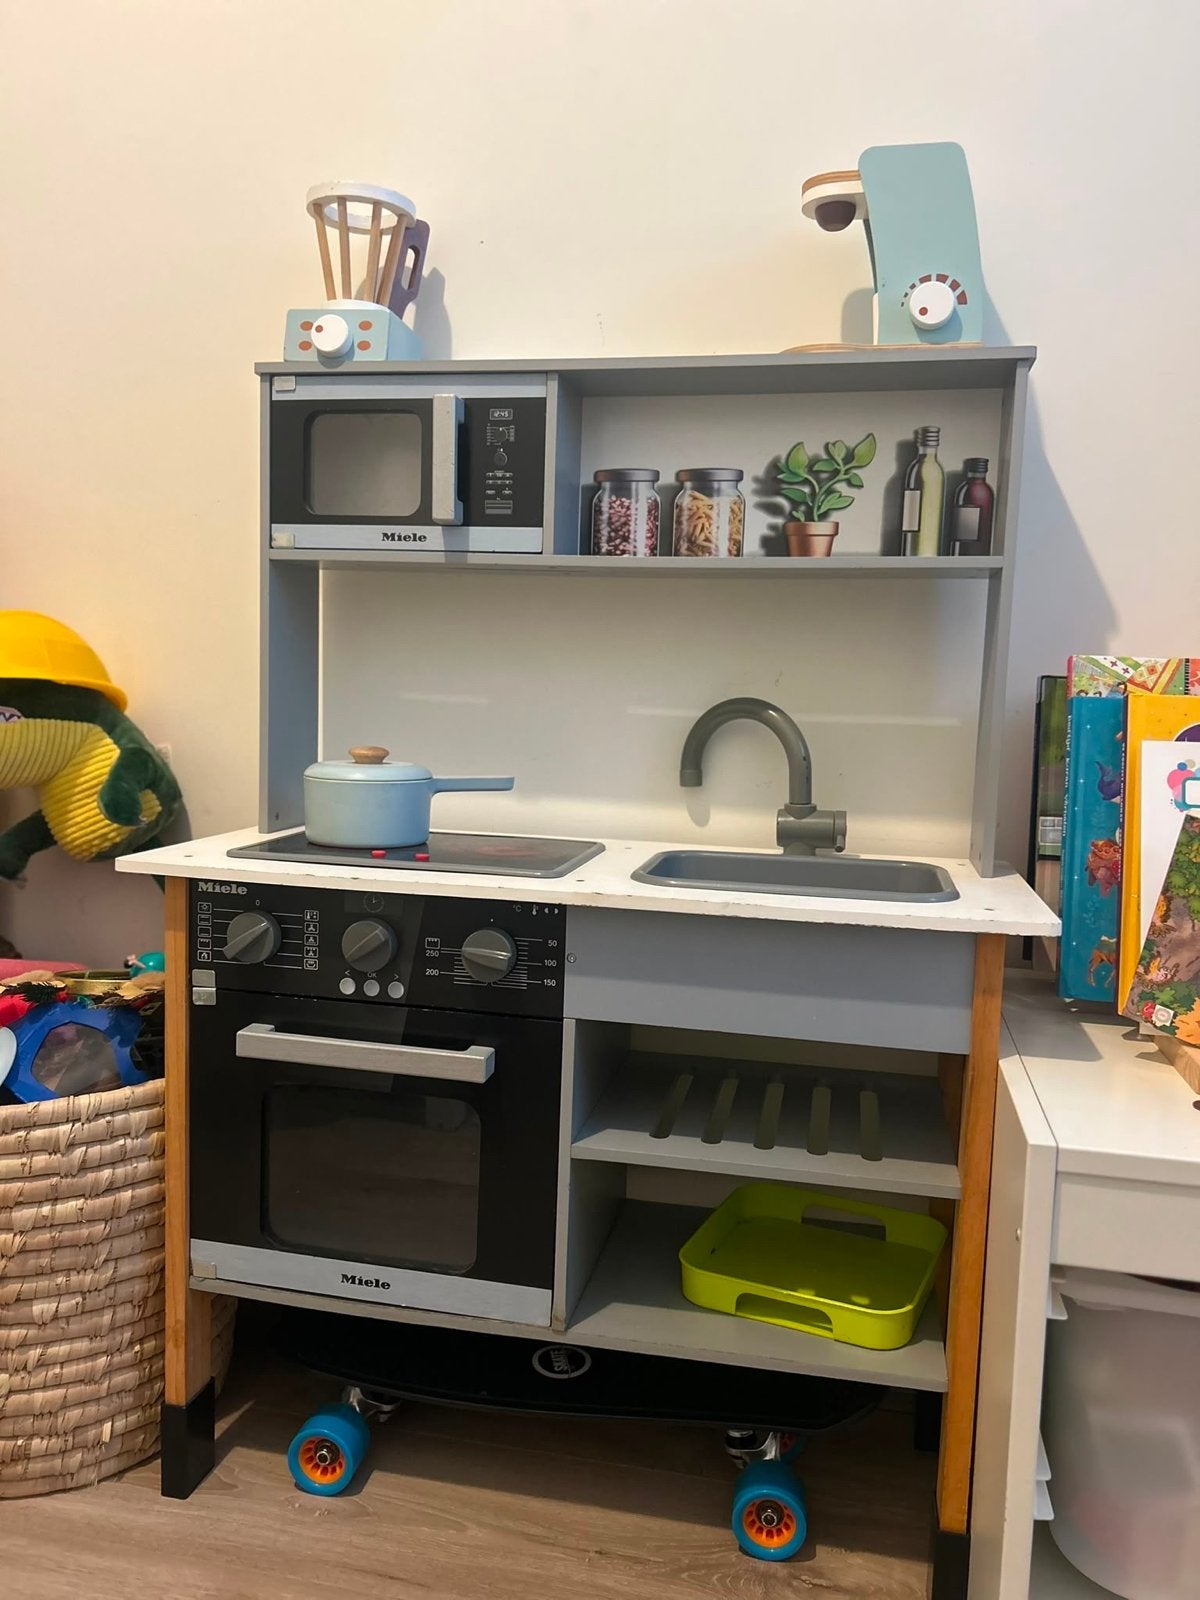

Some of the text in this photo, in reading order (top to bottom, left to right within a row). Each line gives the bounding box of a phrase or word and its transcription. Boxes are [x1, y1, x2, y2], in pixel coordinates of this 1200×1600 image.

[382, 532, 427, 542] Miele
[197, 881, 248, 895] Miele
[548, 939, 558, 947] 50
[425, 949, 440, 957] 250
[544, 959, 557, 967] 100
[367, 971, 378, 979] OK
[425, 968, 440, 976] 200
[543, 979, 557, 987] 150
[341, 1273, 391, 1290] Miele
